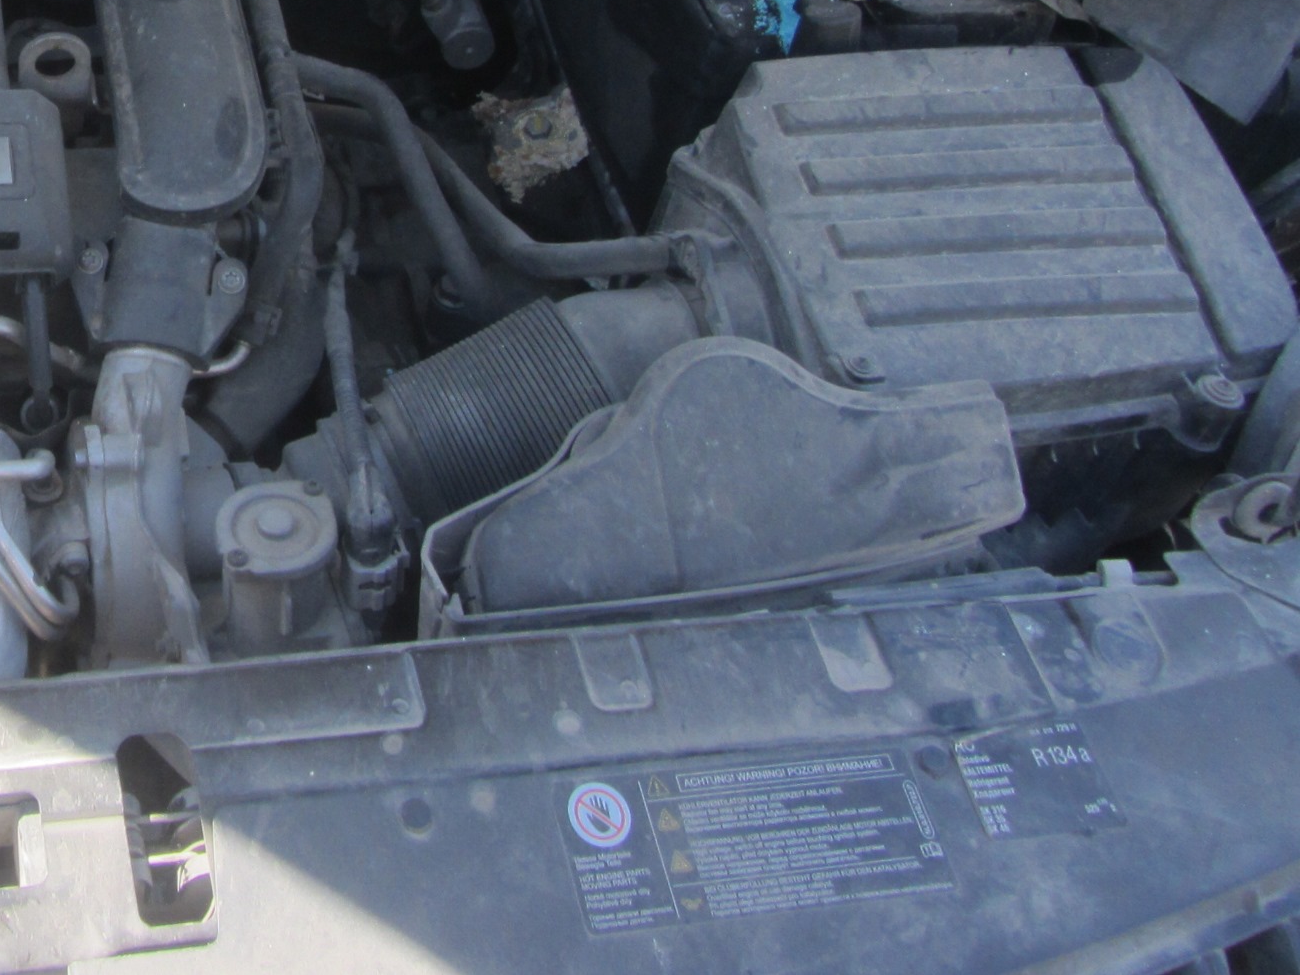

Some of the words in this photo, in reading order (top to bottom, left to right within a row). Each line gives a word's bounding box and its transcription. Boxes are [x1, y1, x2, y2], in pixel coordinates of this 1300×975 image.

[1031, 748, 1049, 767] R
[1047, 745, 1079, 765] 134
[1079, 747, 1092, 763] a
[684, 774, 735, 787] ACHTUNG!
[736, 768, 785, 782] WARNING!
[787, 765, 825, 776] POZOR!
